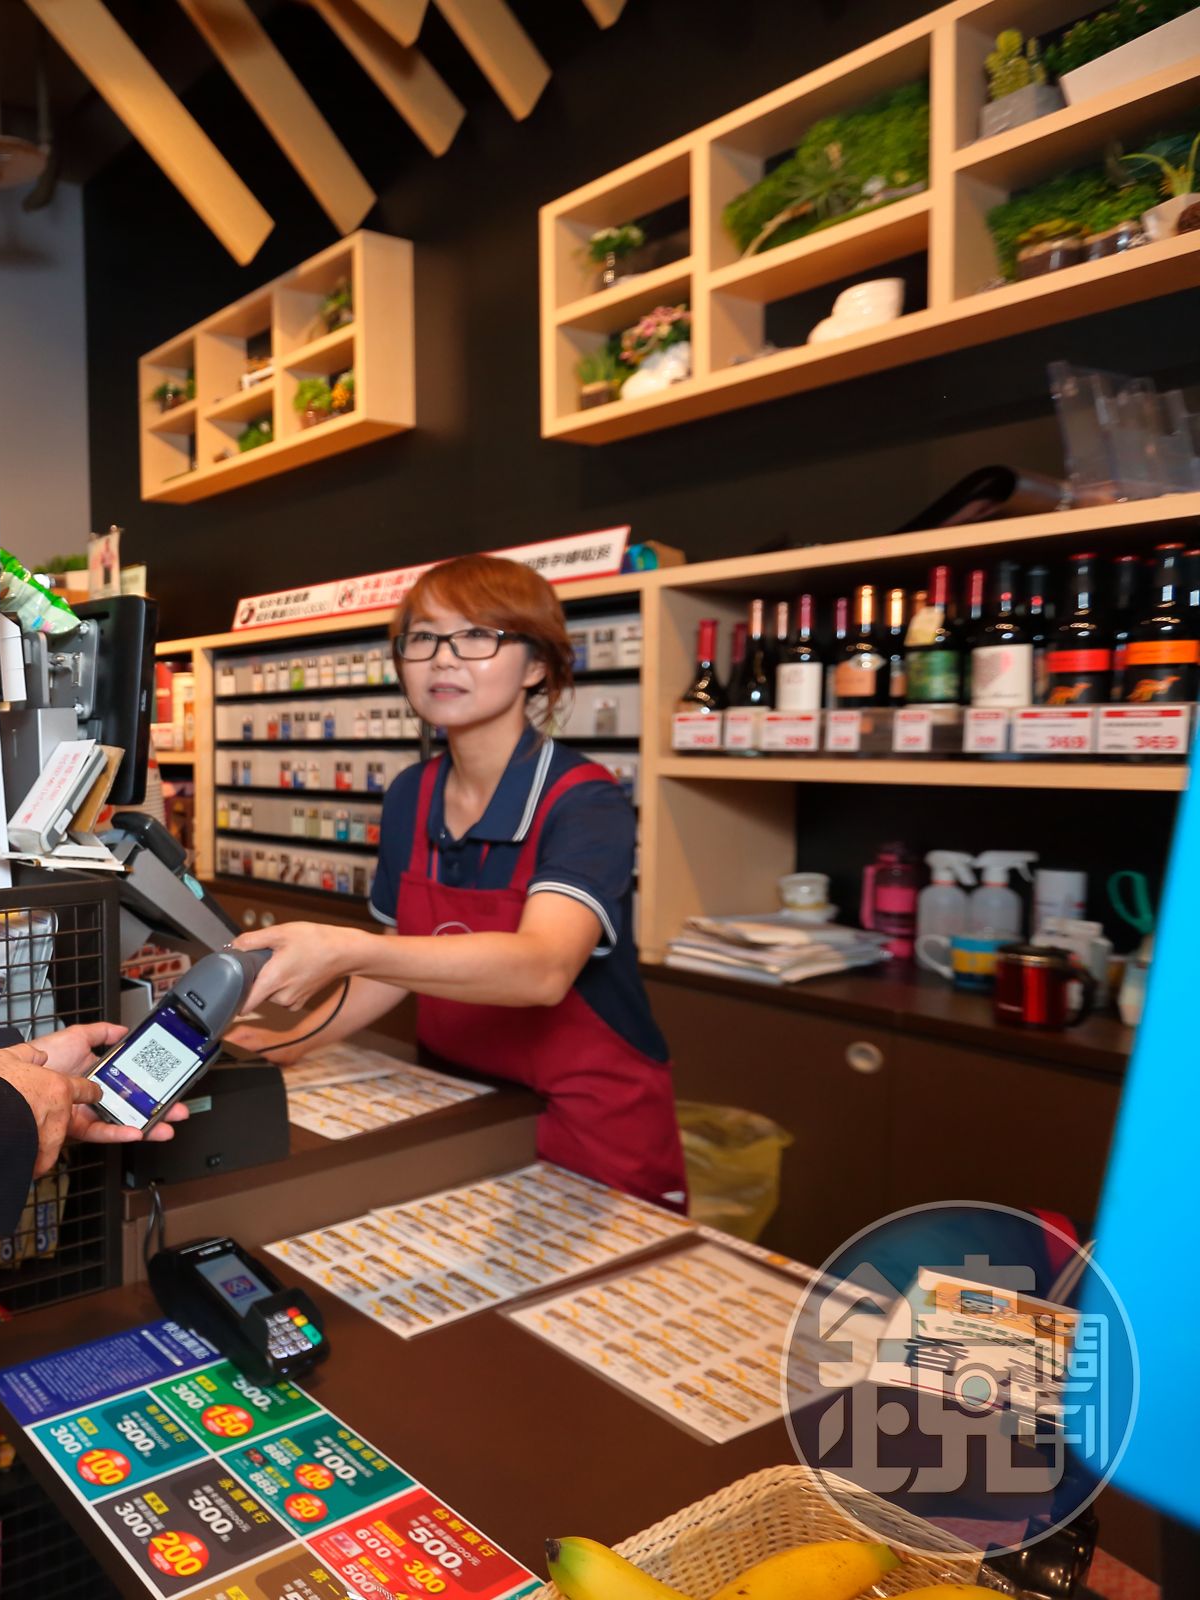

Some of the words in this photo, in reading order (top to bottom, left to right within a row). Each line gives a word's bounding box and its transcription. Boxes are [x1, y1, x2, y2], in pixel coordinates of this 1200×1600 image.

[207, 1405, 249, 1437] 150
[82, 1449, 124, 1486] 100
[337, 1429, 390, 1471] 中國信託
[298, 1464, 331, 1490] 100
[218, 1478, 272, 1525] 永豐銀行
[291, 1497, 321, 1519] 50
[432, 1508, 498, 1558] 台新銀行
[150, 1531, 203, 1576] 200
[403, 1559, 447, 1594] 300
